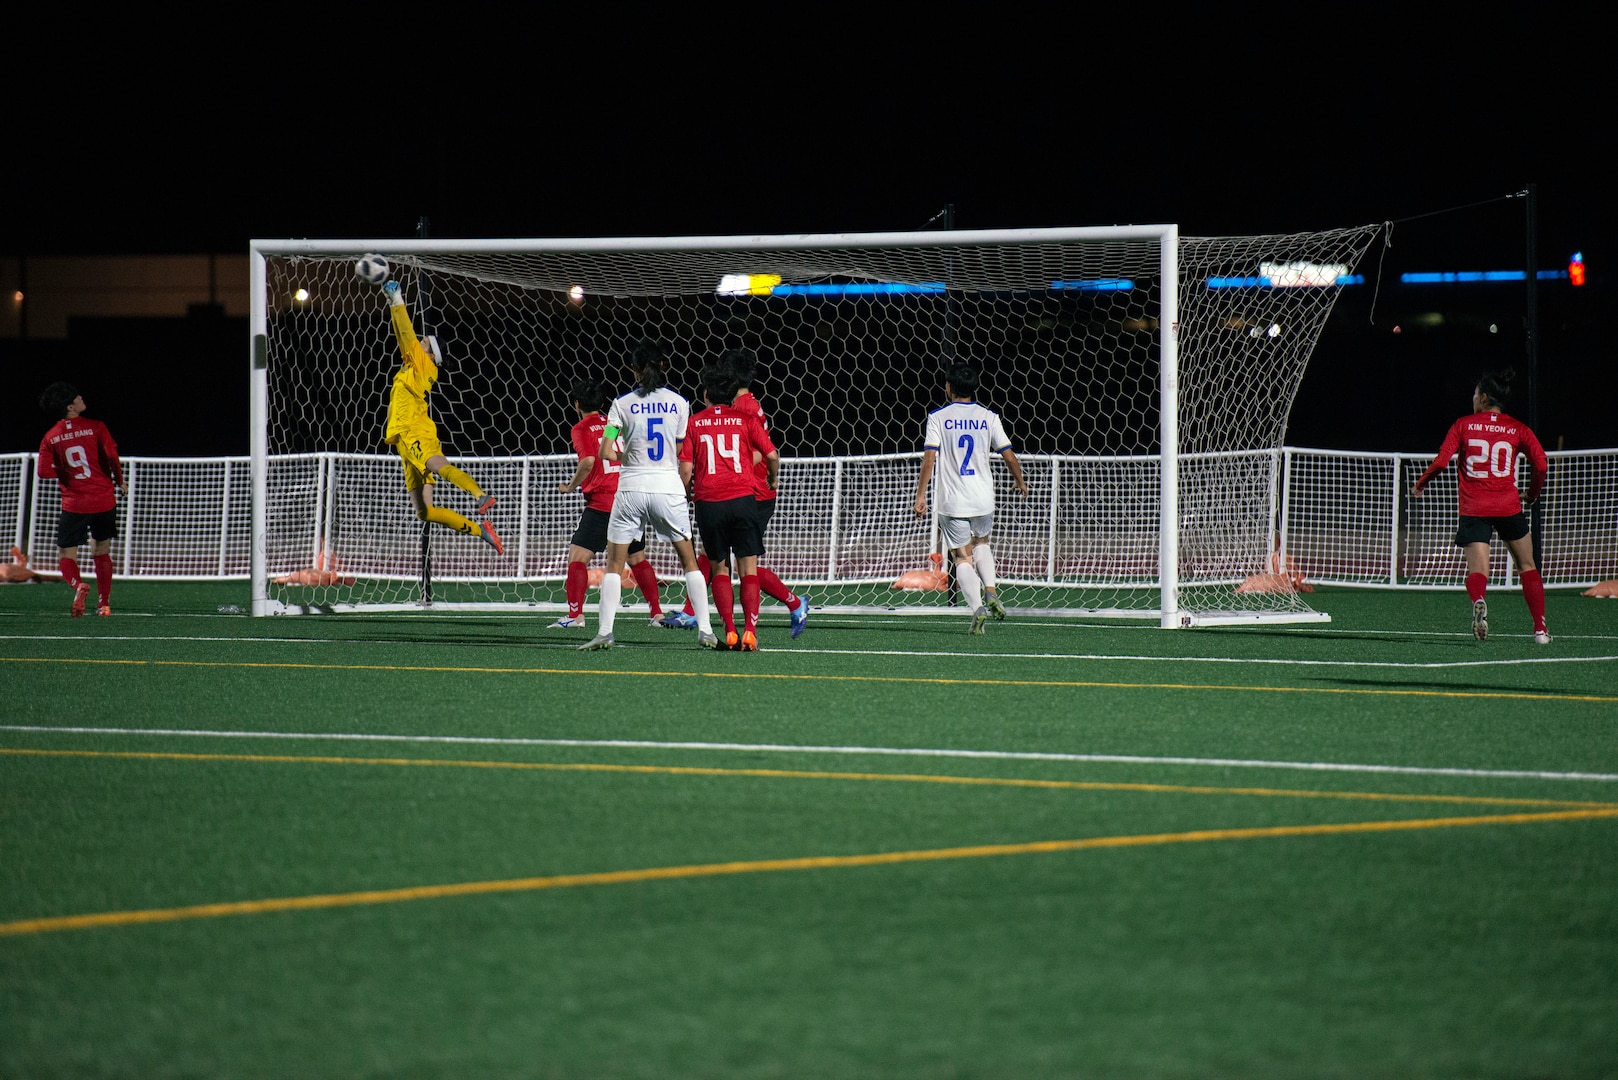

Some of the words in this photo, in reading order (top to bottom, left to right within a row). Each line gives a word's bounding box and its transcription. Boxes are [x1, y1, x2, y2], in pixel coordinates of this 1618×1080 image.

[630, 402, 678, 415] CHINA
[60, 432, 74, 441] LEE
[74, 428, 93, 438] RANG
[695, 418, 711, 427] KIM
[713, 418, 722, 426] JI
[724, 418, 742, 426] HYE
[944, 419, 988, 431] CHINA
[1468, 423, 1482, 432] KIM
[1484, 424, 1506, 433] YEON
[647, 417, 664, 462] 5
[65, 445, 91, 480] 9
[700, 433, 742, 475] 14
[958, 434, 975, 476] 2
[1466, 439, 1512, 478] 20
